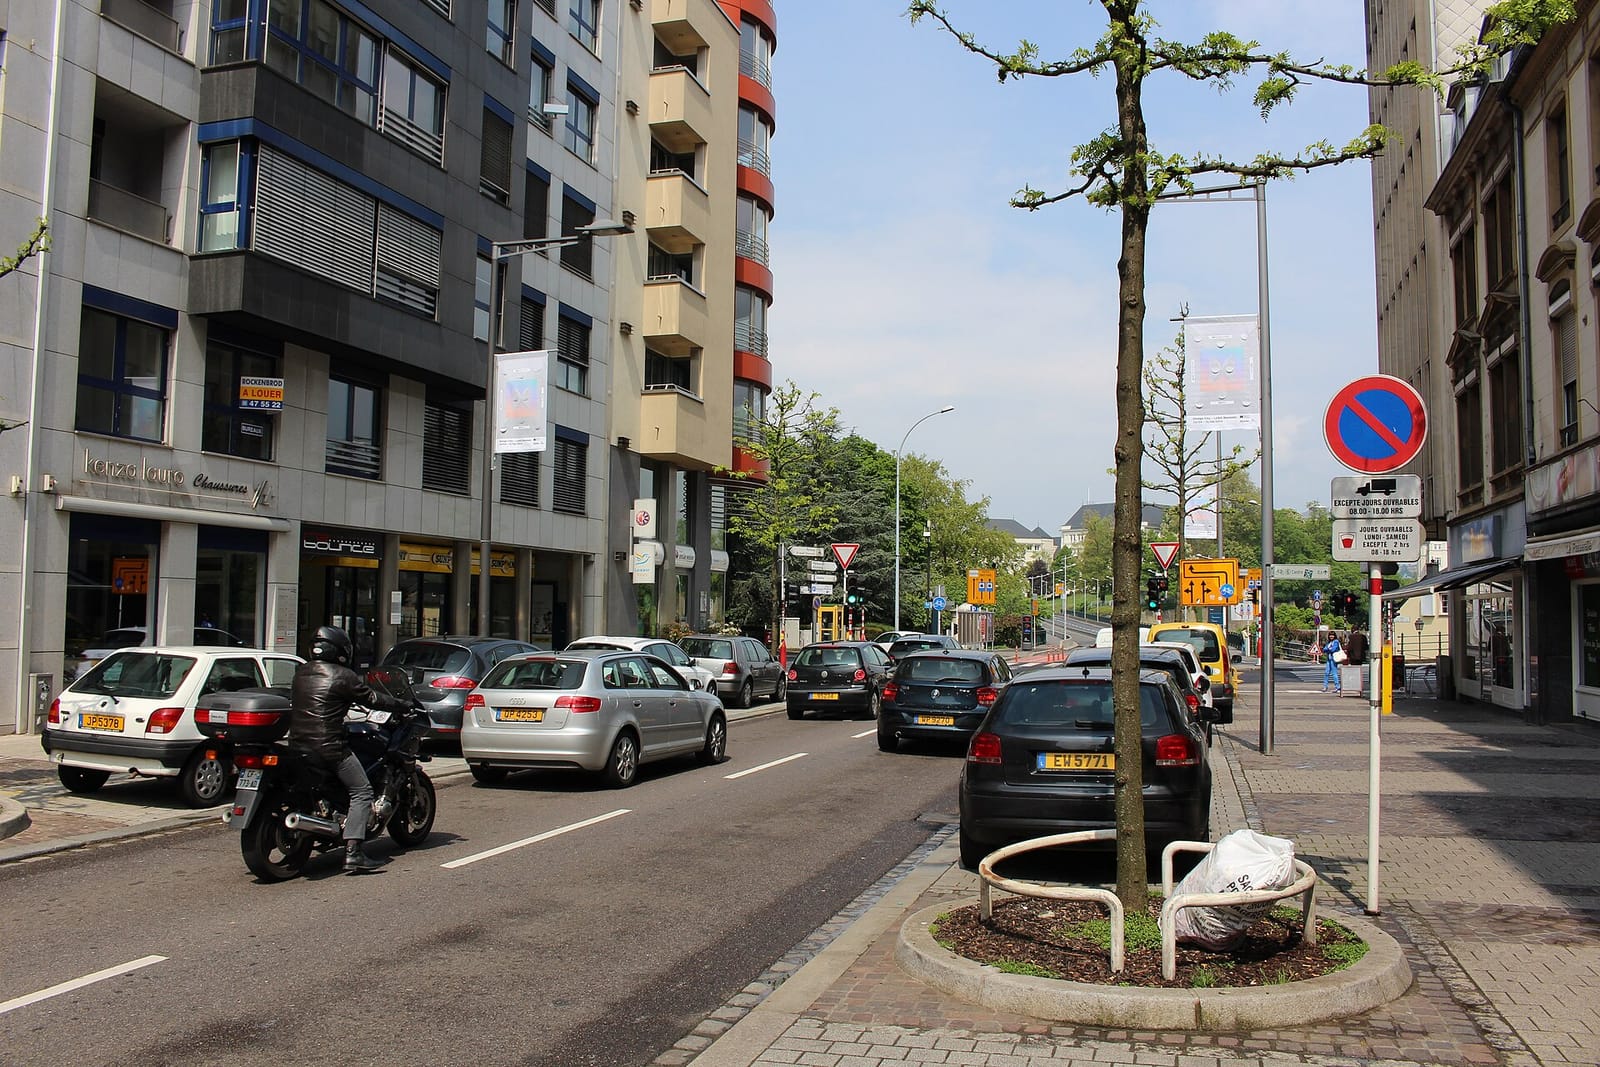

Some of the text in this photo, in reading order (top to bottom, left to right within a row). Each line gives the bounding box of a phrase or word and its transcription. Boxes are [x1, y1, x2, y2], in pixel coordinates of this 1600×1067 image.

[242, 378, 283, 387] ROCKENBROD
[242, 388, 282, 398] A LOUER
[193, 473, 248, 494] Chaussures
[1382, 498, 1419, 506] OUVRABLES
[1372, 507, 1390, 515] 18.00
[303, 539, 375, 554] bounce
